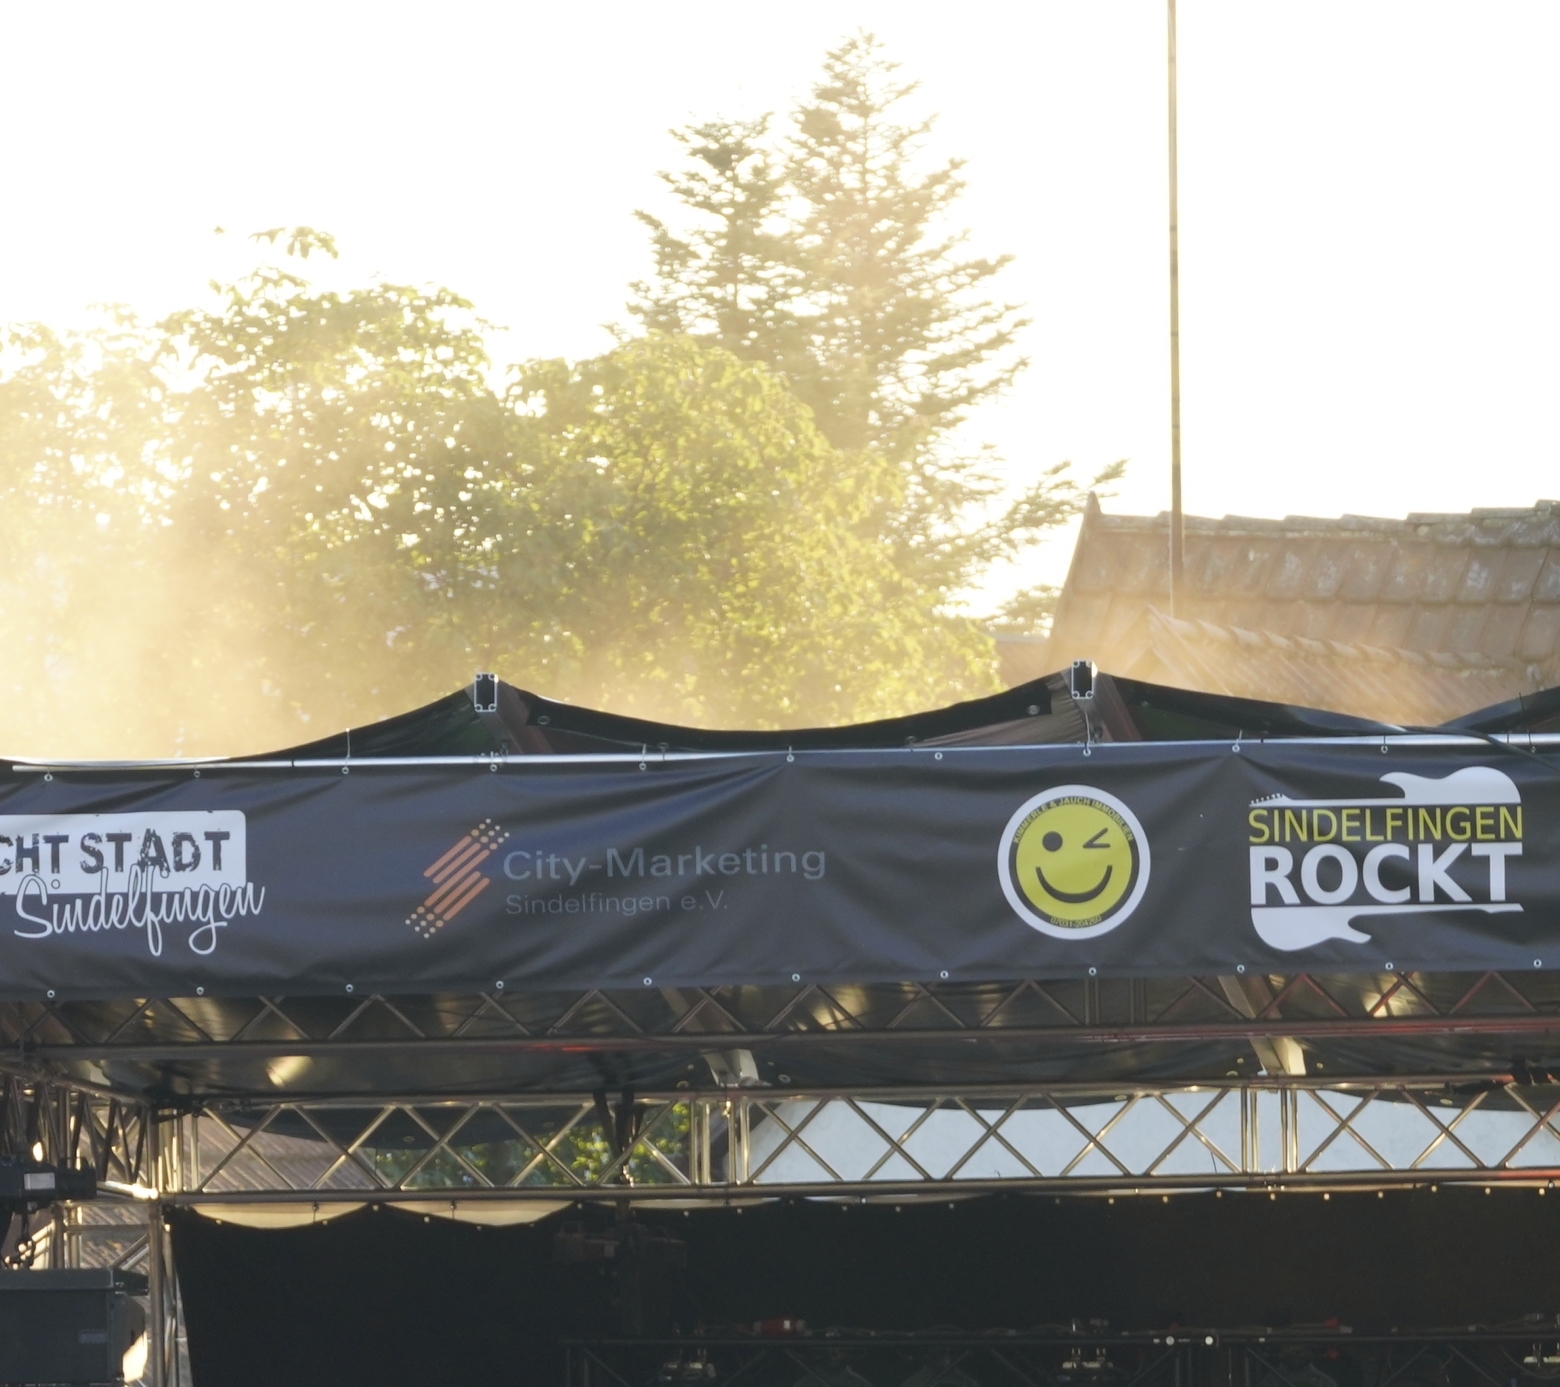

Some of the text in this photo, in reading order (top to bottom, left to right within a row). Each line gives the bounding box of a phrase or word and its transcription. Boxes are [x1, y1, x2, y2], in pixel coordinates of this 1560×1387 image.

[1013, 801, 1048, 844] KIMMERLE
[1058, 797, 1090, 806] JAUCH
[1091, 798, 1134, 841] IMMOBILIEN
[1248, 806, 1523, 842] SINDELFINGEN
[80, 829, 230, 874] STADT
[503, 844, 826, 885] City-Marketing
[1249, 842, 1523, 905] ROCKT
[14, 864, 265, 956] Sindelfingen
[506, 890, 728, 916] Sindelfingen e.V.
